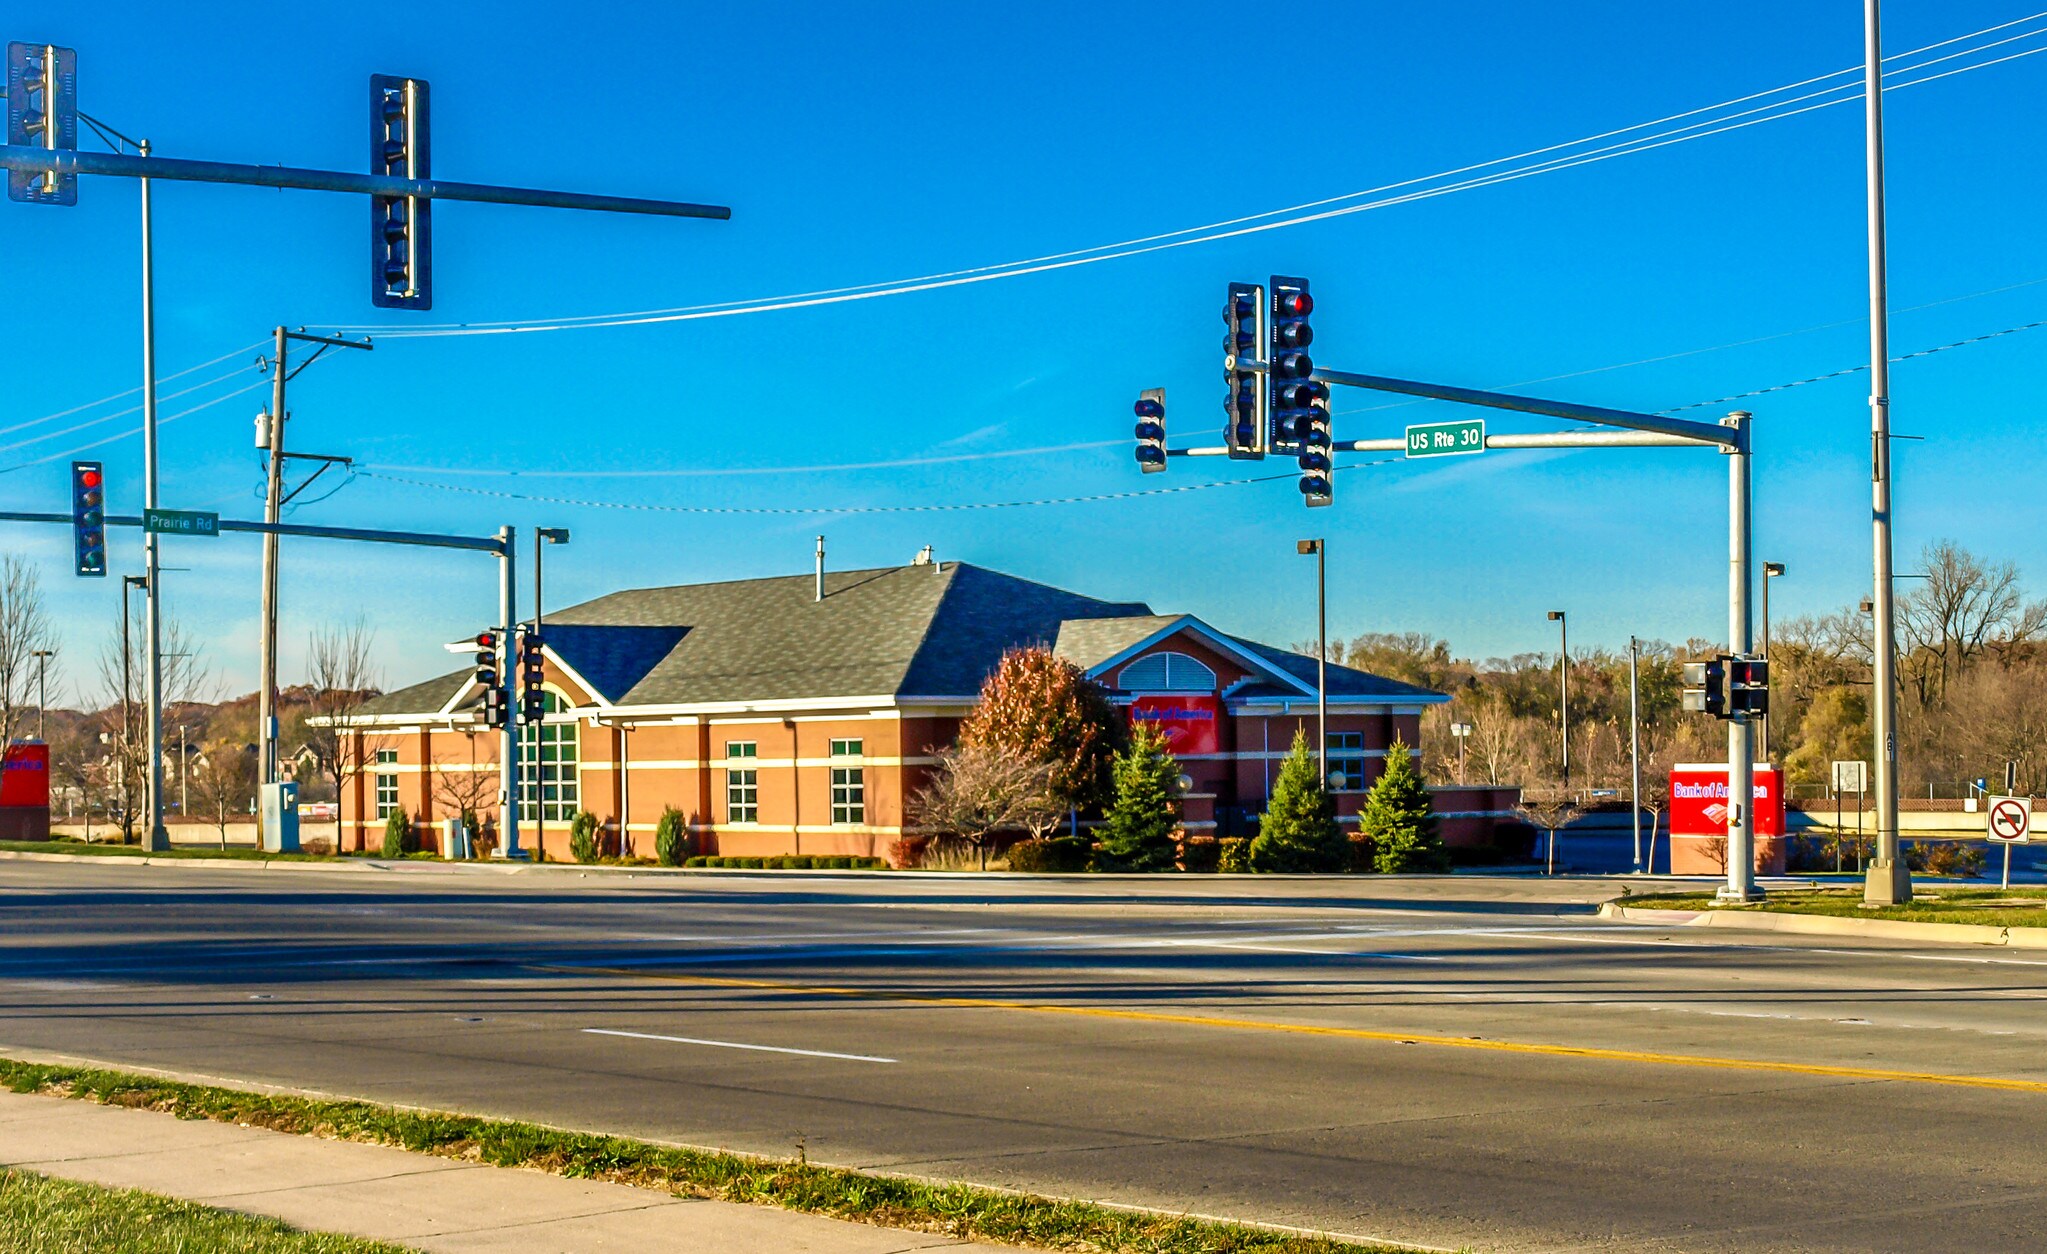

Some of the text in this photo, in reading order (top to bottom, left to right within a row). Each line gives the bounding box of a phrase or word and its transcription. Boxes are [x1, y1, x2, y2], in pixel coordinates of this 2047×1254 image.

[1410, 428, 1479, 450] US Rte 30
[150, 514, 213, 531] Prairie Rd
[1674, 782, 1703, 798] Bank
[1703, 782, 1715, 798] of
